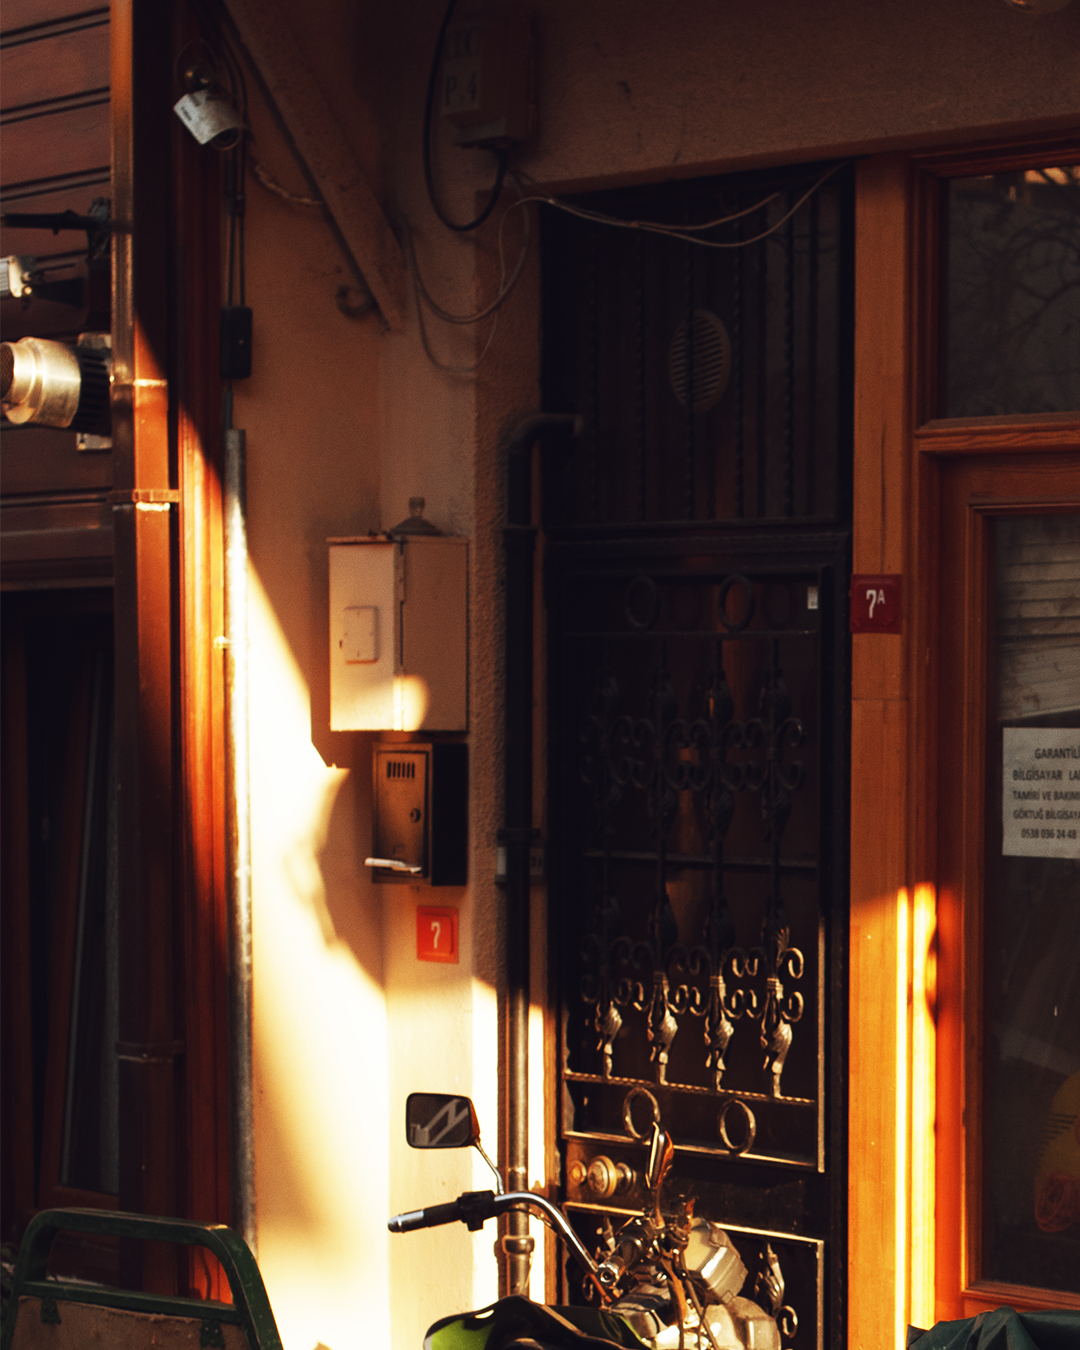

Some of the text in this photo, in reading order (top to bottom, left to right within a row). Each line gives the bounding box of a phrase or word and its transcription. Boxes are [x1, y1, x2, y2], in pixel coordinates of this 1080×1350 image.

[866, 589, 886, 619] 7A
[1035, 745, 1080, 759] GARANTİLİ
[1013, 767, 1062, 780] BİLGİSAYAR
[1042, 791, 1051, 801] VE
[431, 921, 441, 949] 7
